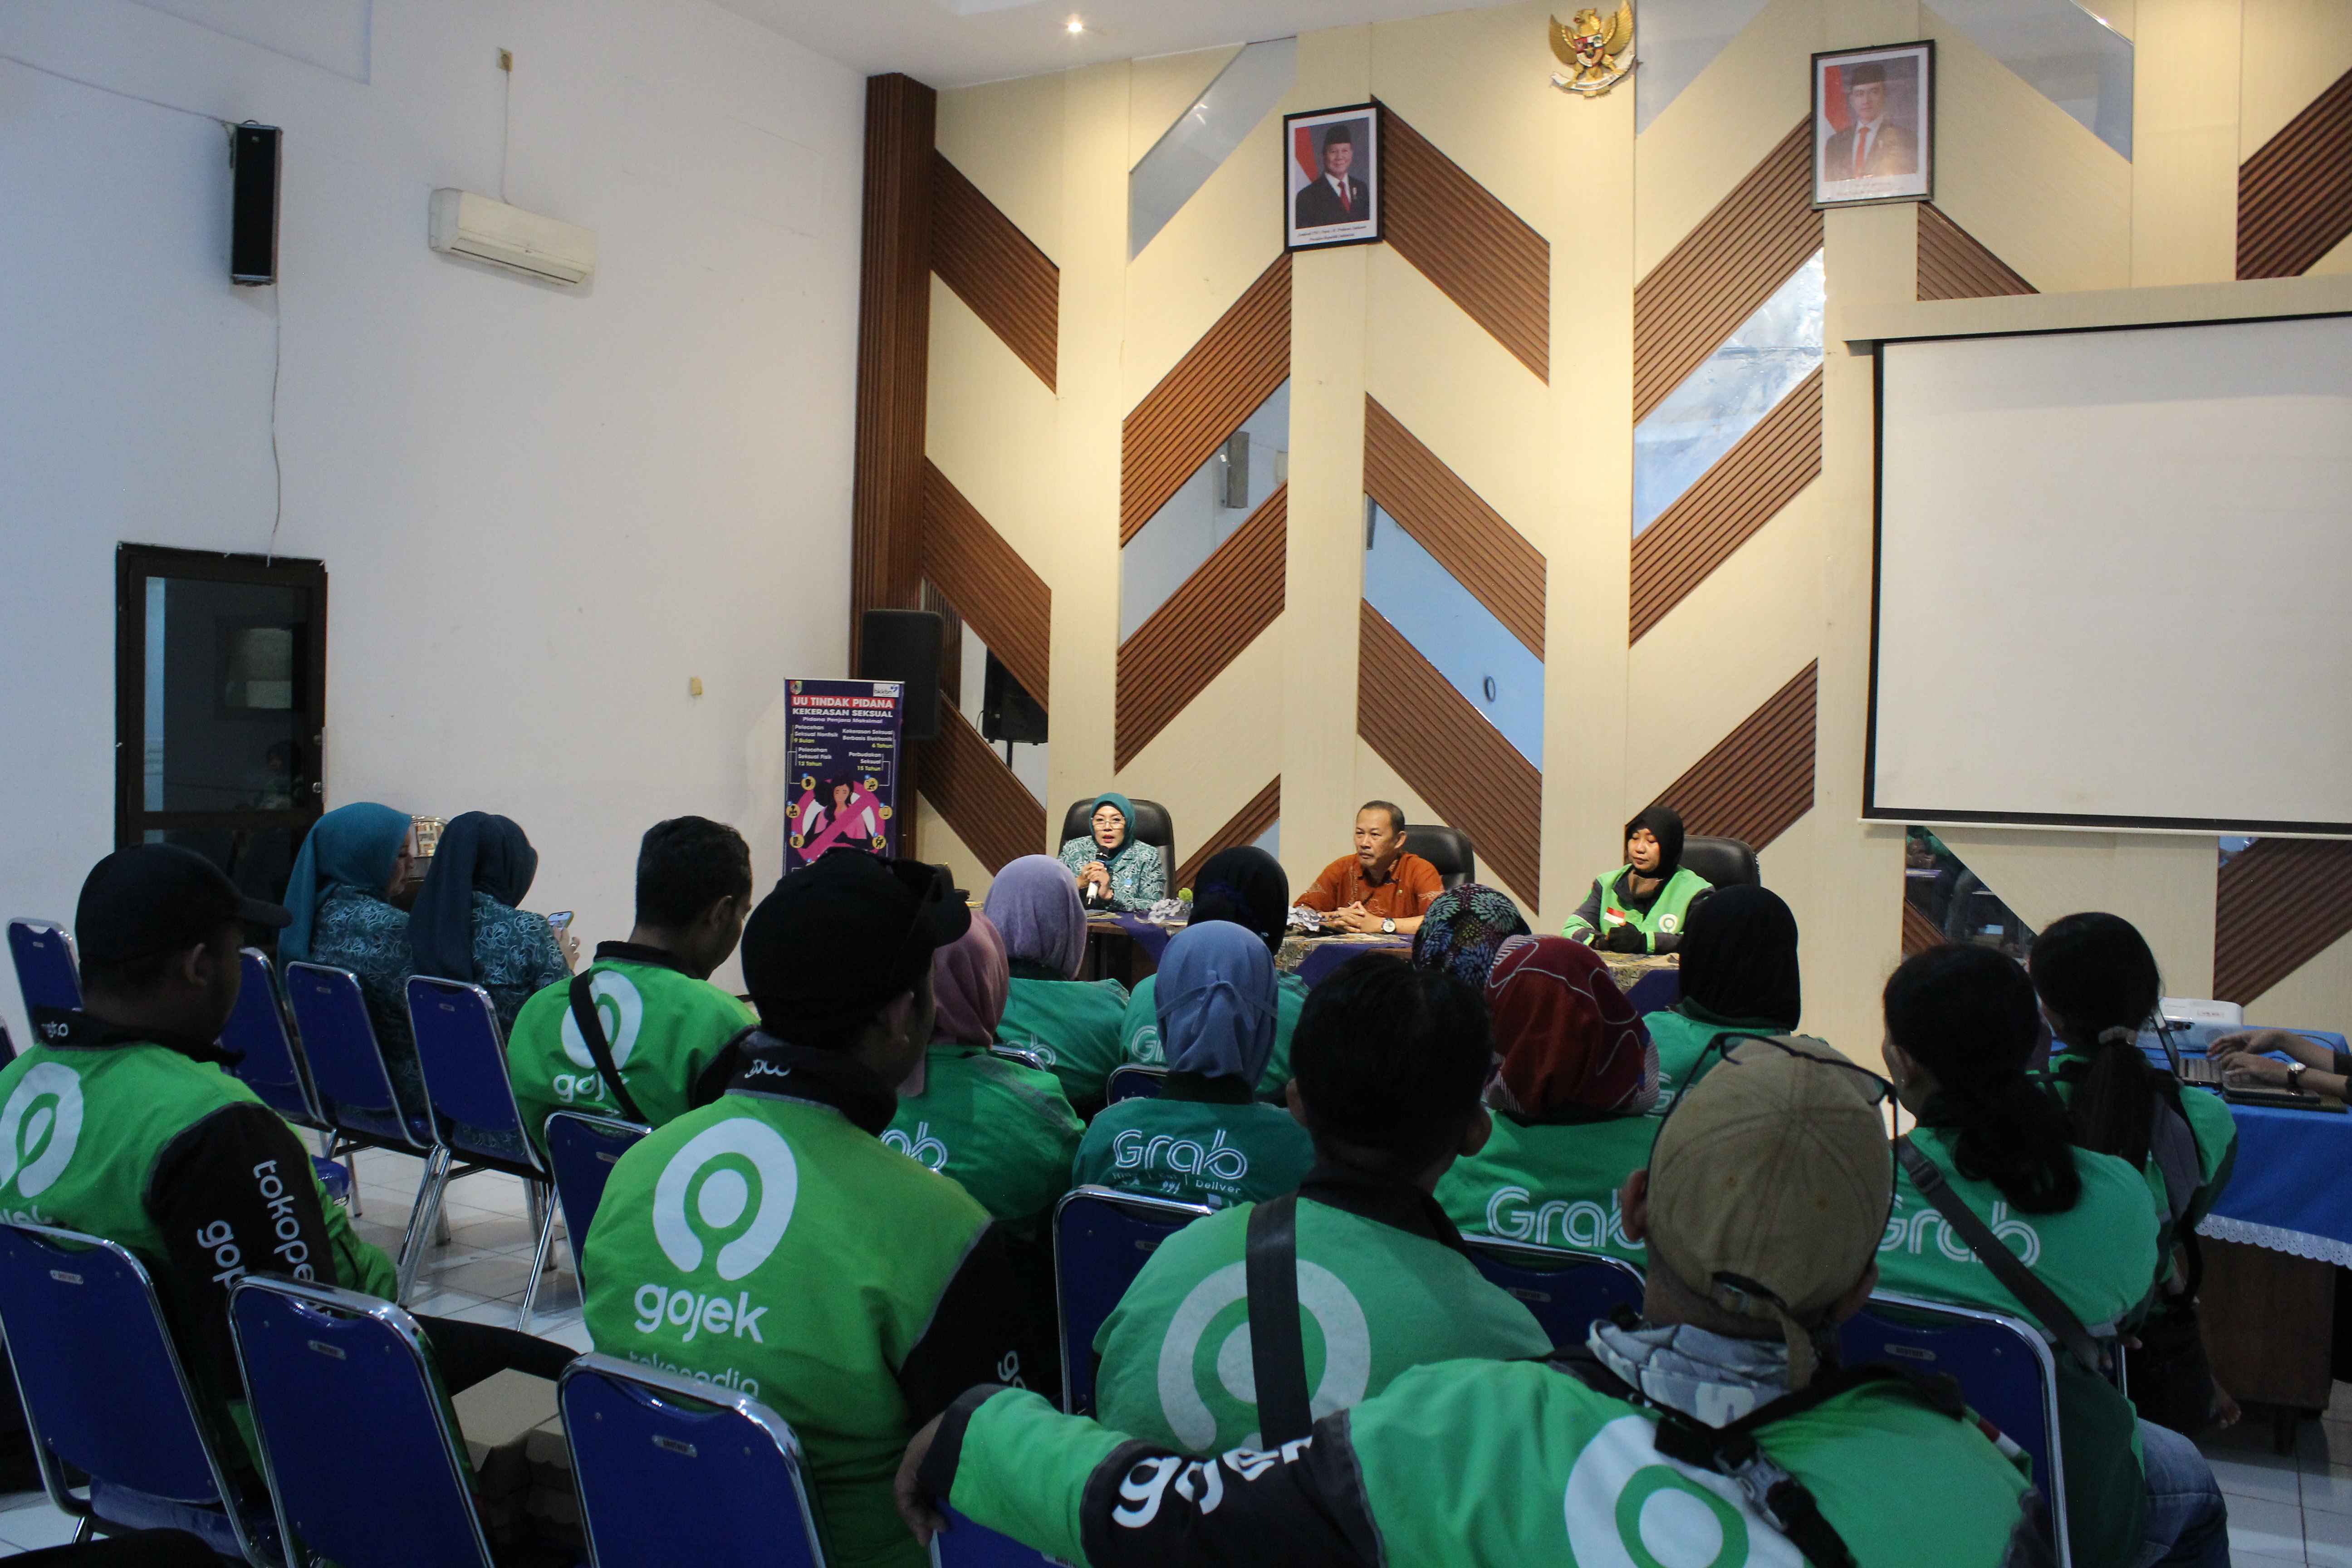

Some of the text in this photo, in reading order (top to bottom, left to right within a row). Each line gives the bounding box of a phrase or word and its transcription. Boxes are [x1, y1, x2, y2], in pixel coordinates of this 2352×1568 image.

[793, 708, 893, 718] KEKERASAN SEKSUAL
[794, 696, 893, 708] UU TINDAK PIDANA
[1113, 1129, 1248, 1180] Grab
[634, 1284, 769, 1343] gojek
